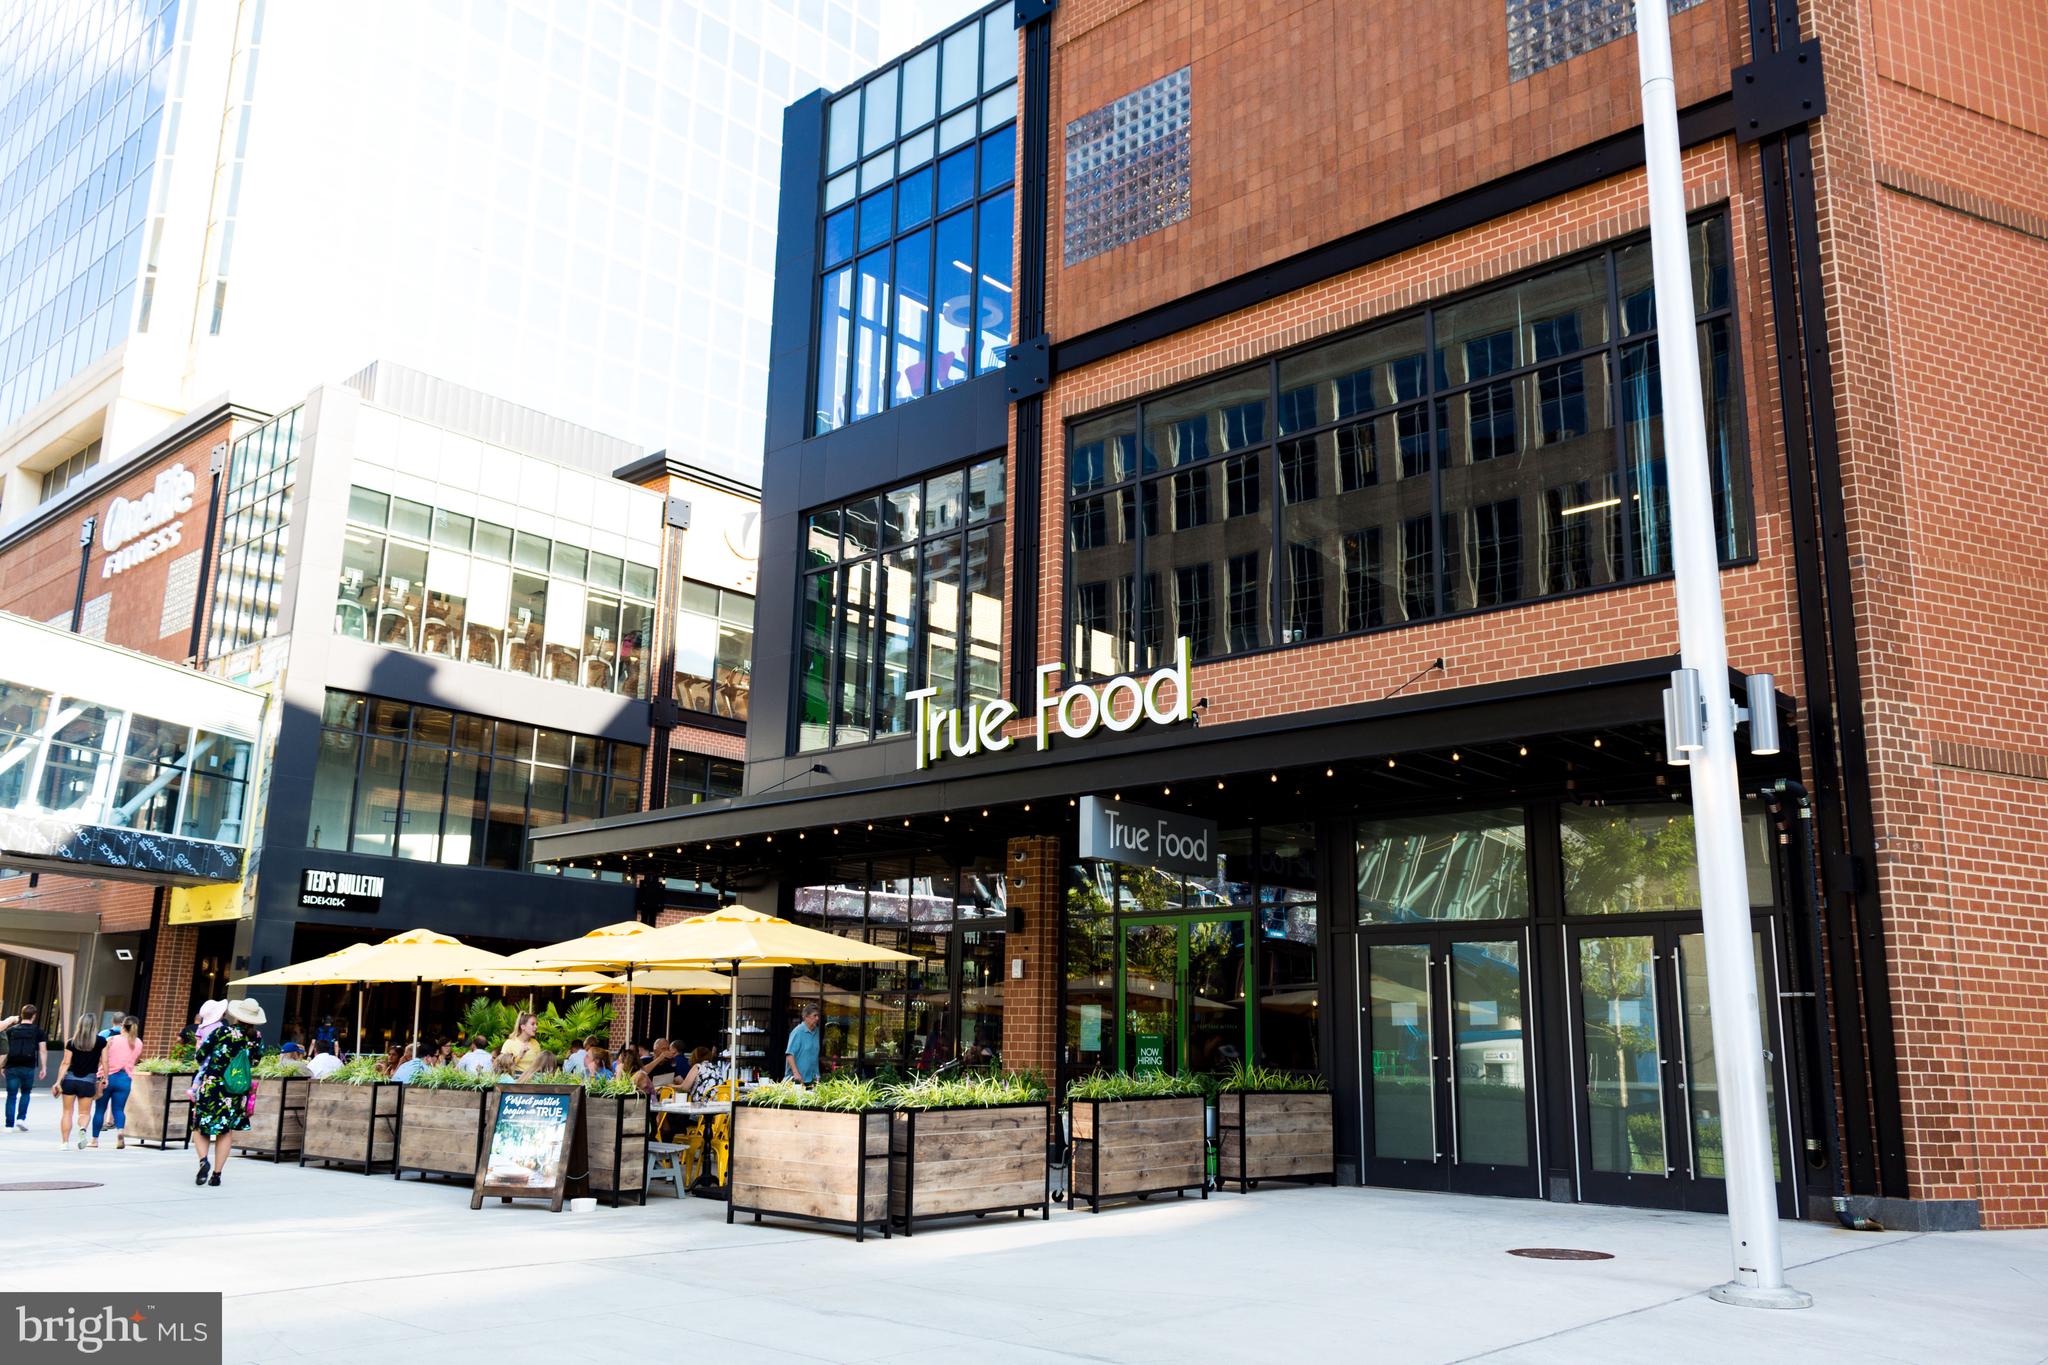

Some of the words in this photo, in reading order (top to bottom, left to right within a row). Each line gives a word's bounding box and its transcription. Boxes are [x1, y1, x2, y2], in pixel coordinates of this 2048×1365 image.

[102, 521, 184, 578] FITNESS
[905, 687, 1018, 769] True
[1037, 636, 1192, 751] Food
[1104, 809, 1150, 852] True
[1157, 819, 1208, 862] Food
[176, 853, 200, 876] GRAC
[306, 870, 336, 893] TED'S
[337, 872, 384, 898] BULLETIN
[303, 895, 346, 907] SIDEKICK
[1137, 1056, 1162, 1065] HIRING
[1140, 1047, 1160, 1056] NOW
[505, 1095, 534, 1106] Perfect
[531, 1097, 560, 1107] parties
[503, 1105, 526, 1118] begin
[536, 1107, 563, 1117] TRUE
